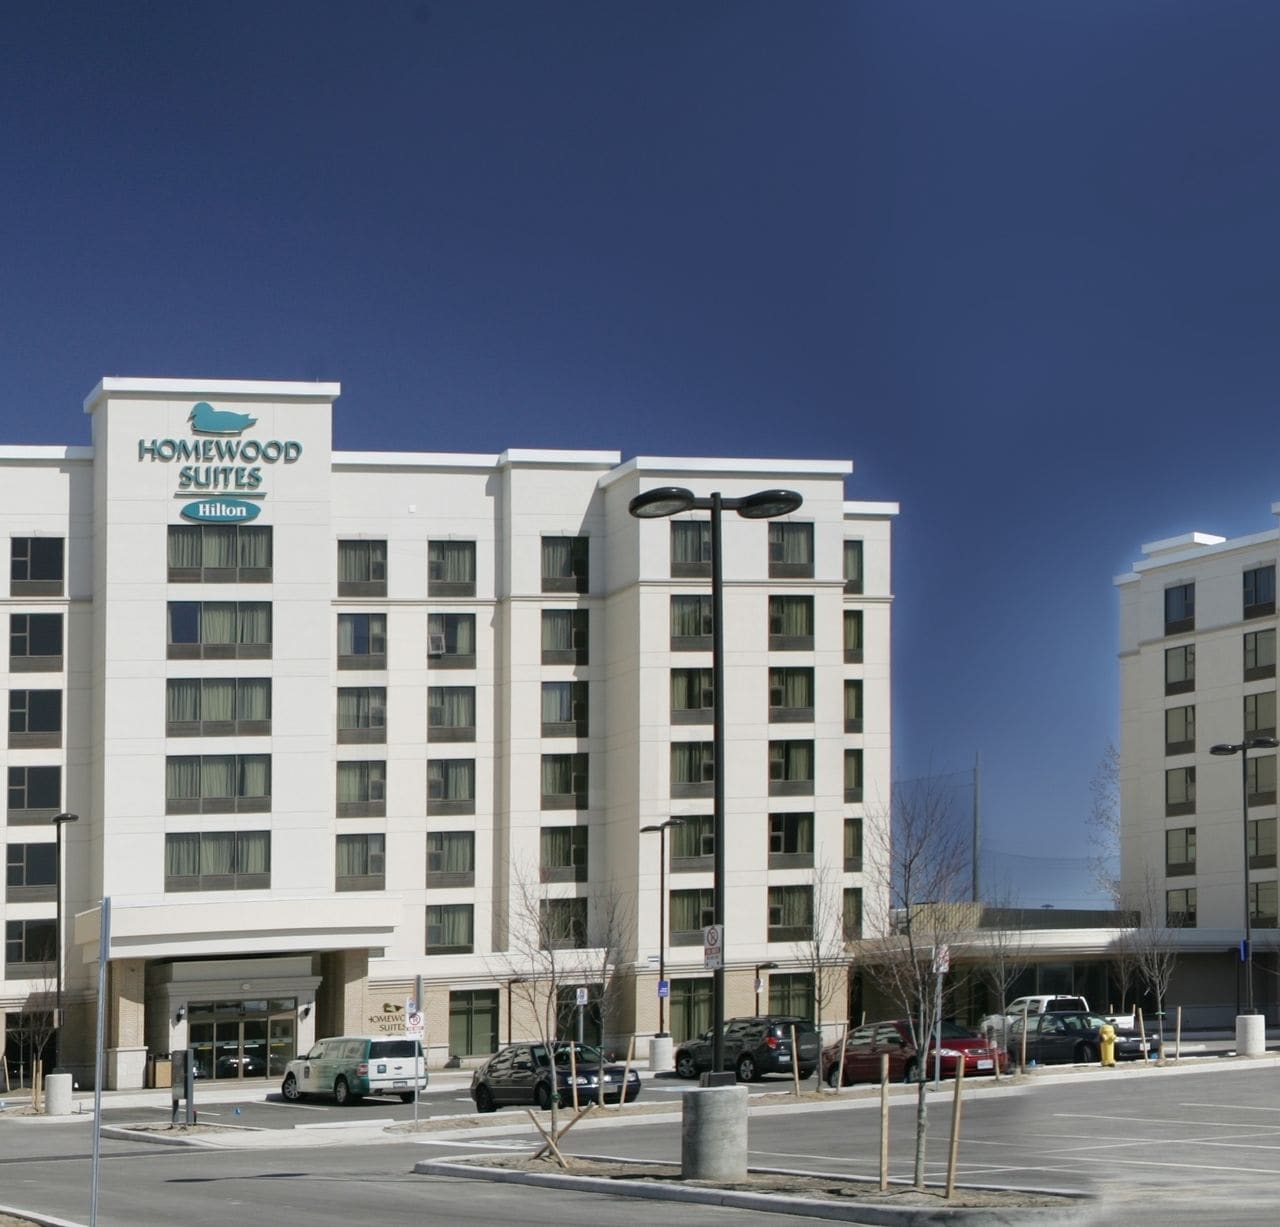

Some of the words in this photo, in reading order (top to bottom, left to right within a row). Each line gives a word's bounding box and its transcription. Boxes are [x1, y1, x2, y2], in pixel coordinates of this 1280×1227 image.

[138, 439, 303, 464] HOMEWOOD
[178, 465, 263, 490] SUITES
[198, 502, 247, 517] Hilton
